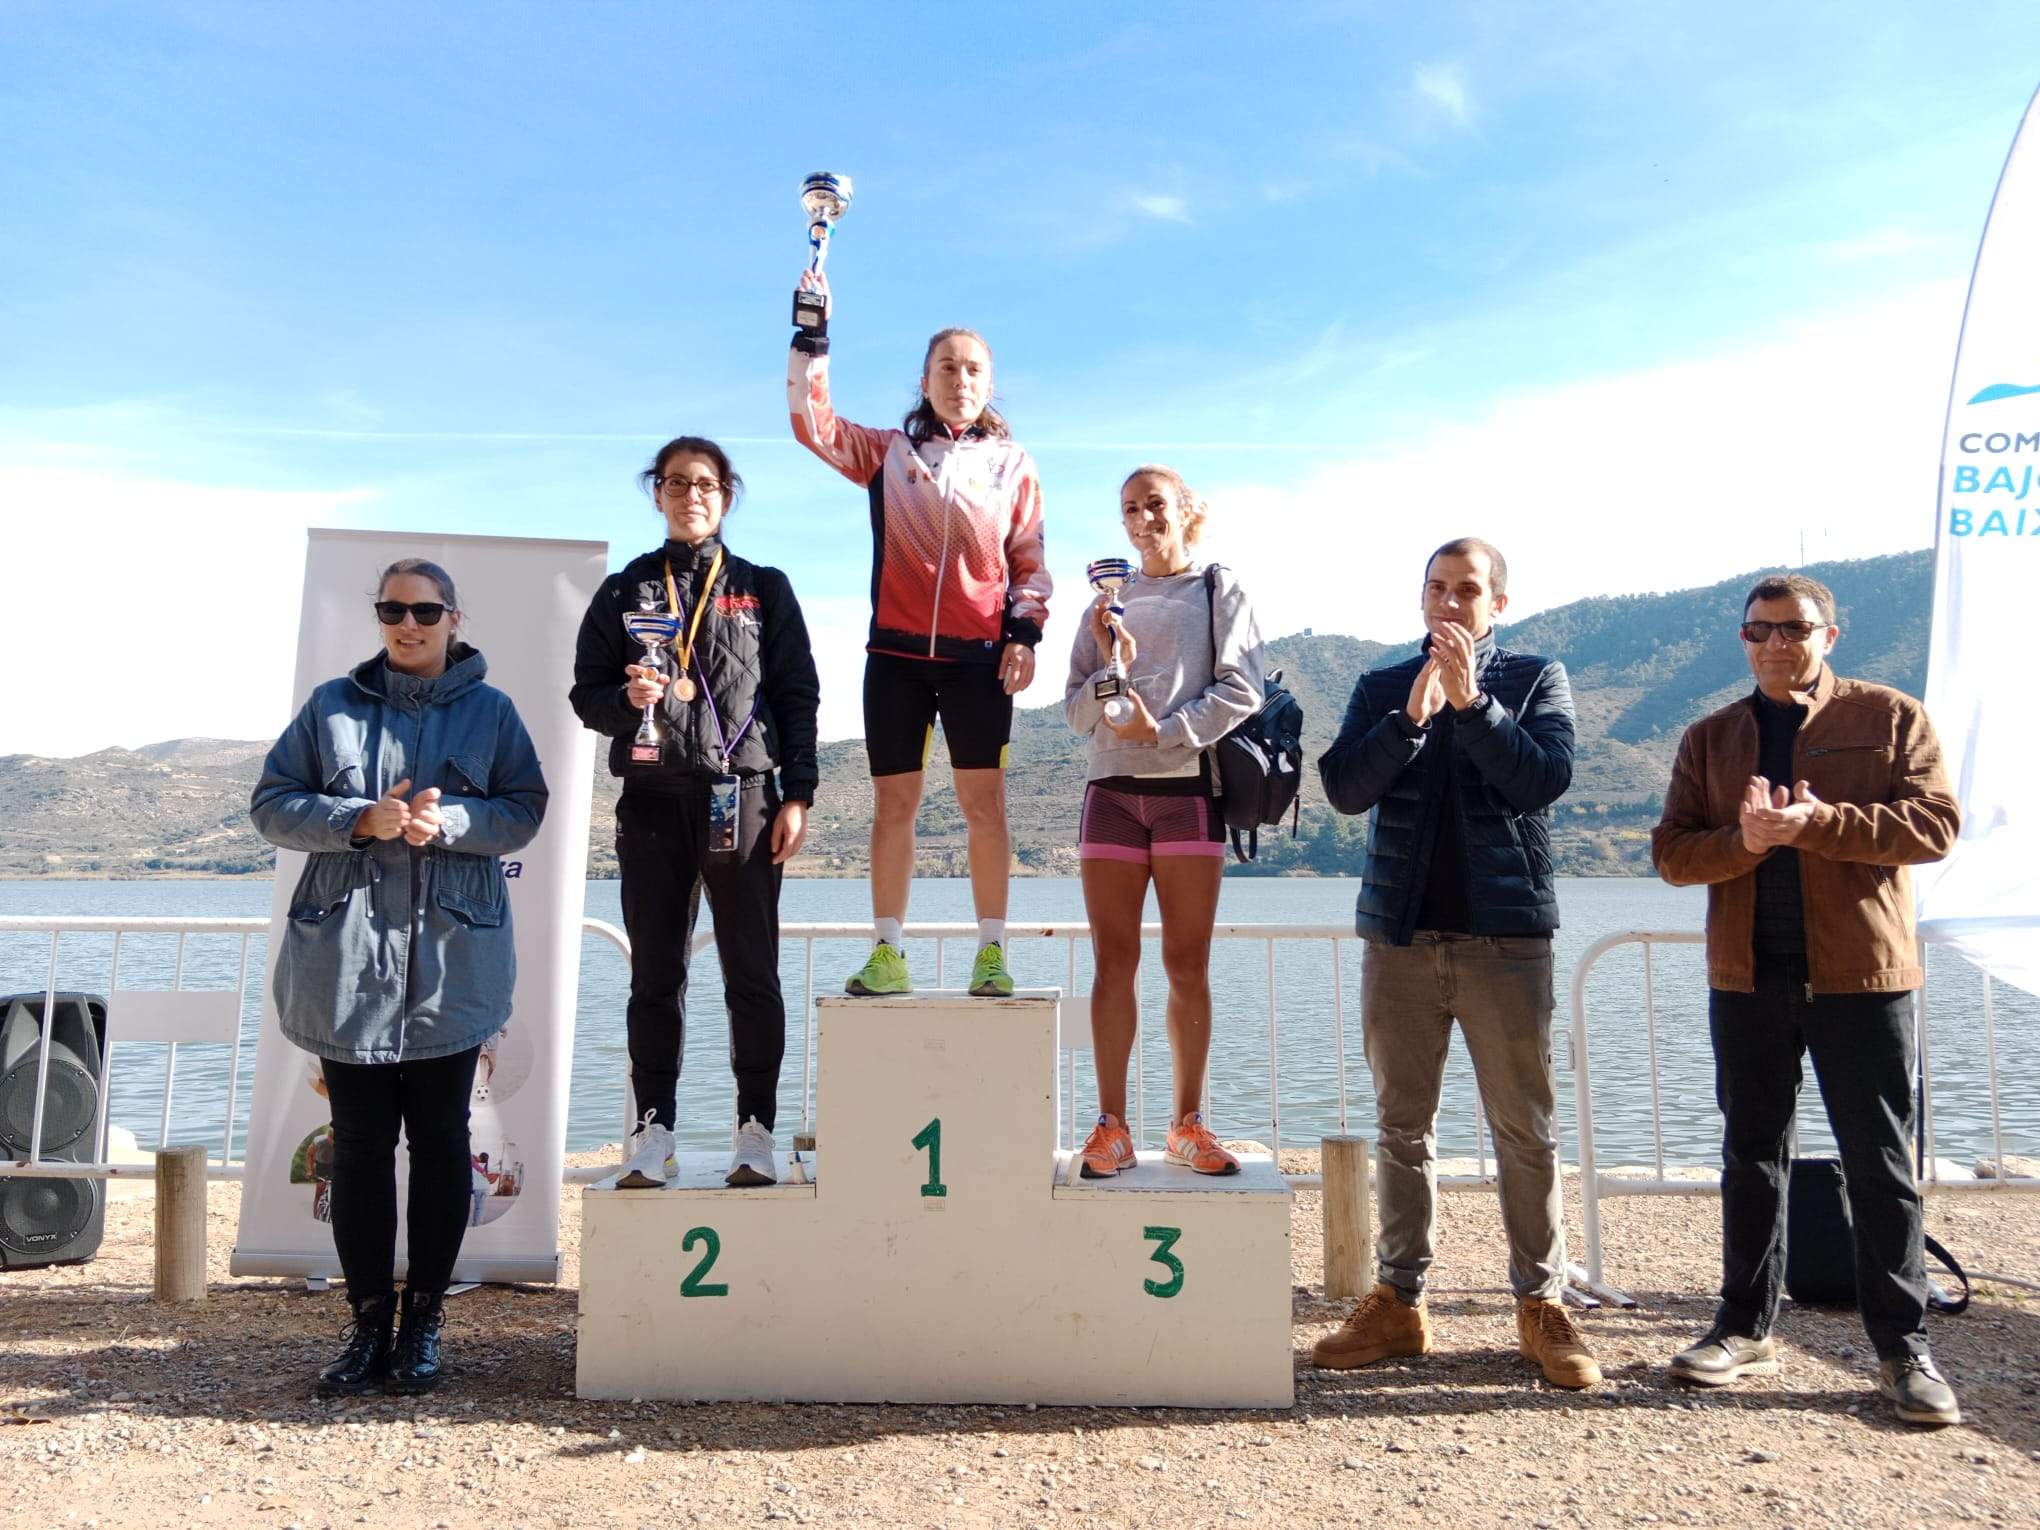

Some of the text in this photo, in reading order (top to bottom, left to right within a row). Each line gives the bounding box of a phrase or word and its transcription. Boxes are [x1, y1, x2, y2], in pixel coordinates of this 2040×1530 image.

[1953, 465, 2040, 500] BAJ
[911, 1117, 947, 1197] 1
[25, 1233, 57, 1242] VONYX
[680, 1226, 729, 1297] 2
[1144, 1226, 1185, 1298] 3
